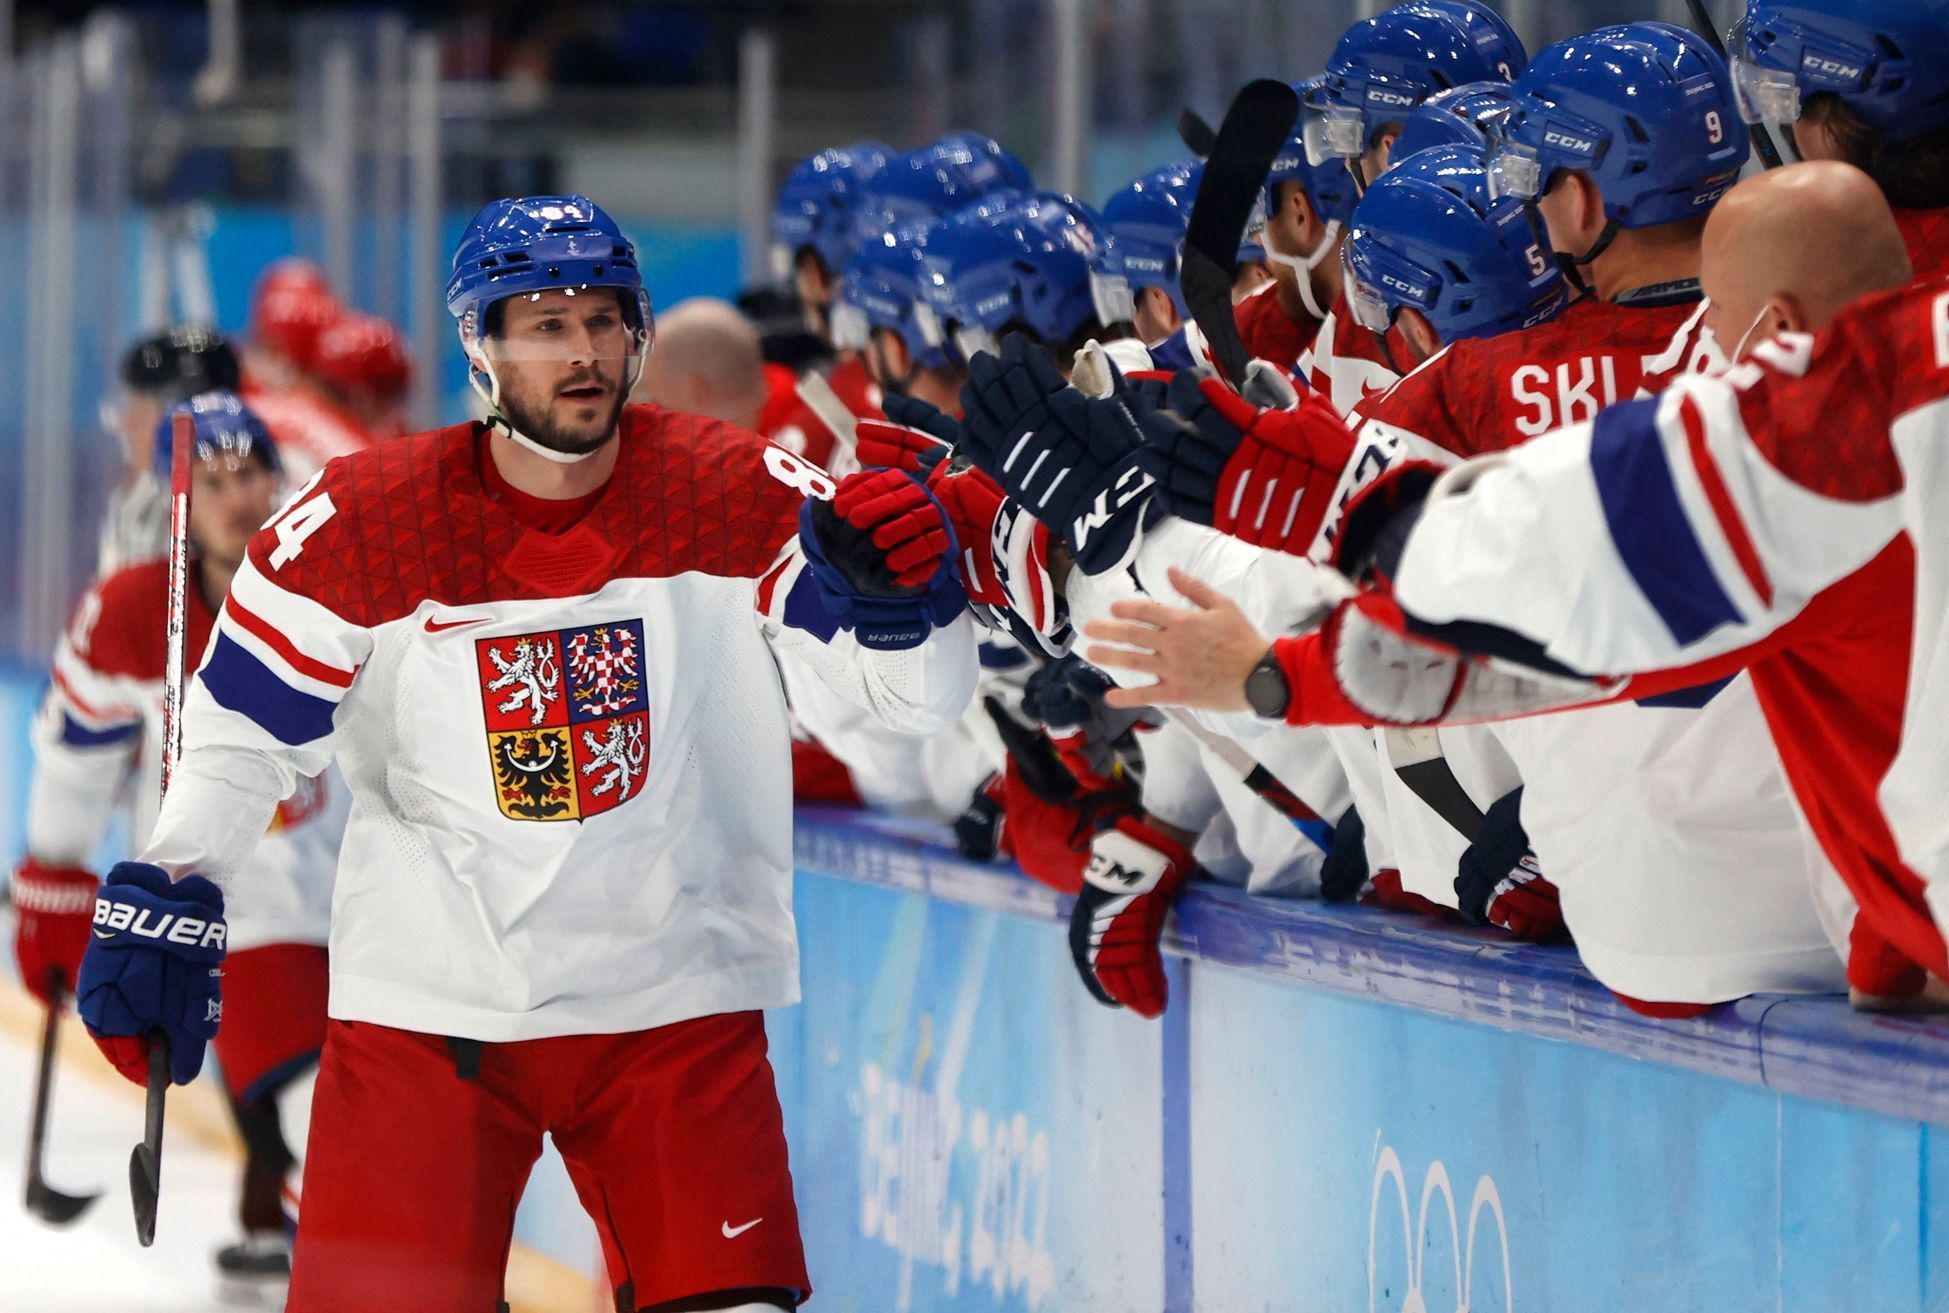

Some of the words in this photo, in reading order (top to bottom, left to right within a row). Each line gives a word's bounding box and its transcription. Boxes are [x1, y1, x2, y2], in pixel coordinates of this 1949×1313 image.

[1803, 55, 1860, 79] CCM
[1367, 90, 1414, 107] CCM
[1705, 110, 1723, 144] 9
[1544, 131, 1592, 152] CCM
[1270, 157, 1299, 172] CM
[1692, 188, 1728, 205] CC
[1525, 243, 1546, 276] 5
[1382, 273, 1425, 297] CCM
[1511, 355, 1656, 436] SKL
[762, 439, 837, 501] 8
[1091, 854, 1146, 888] CM
